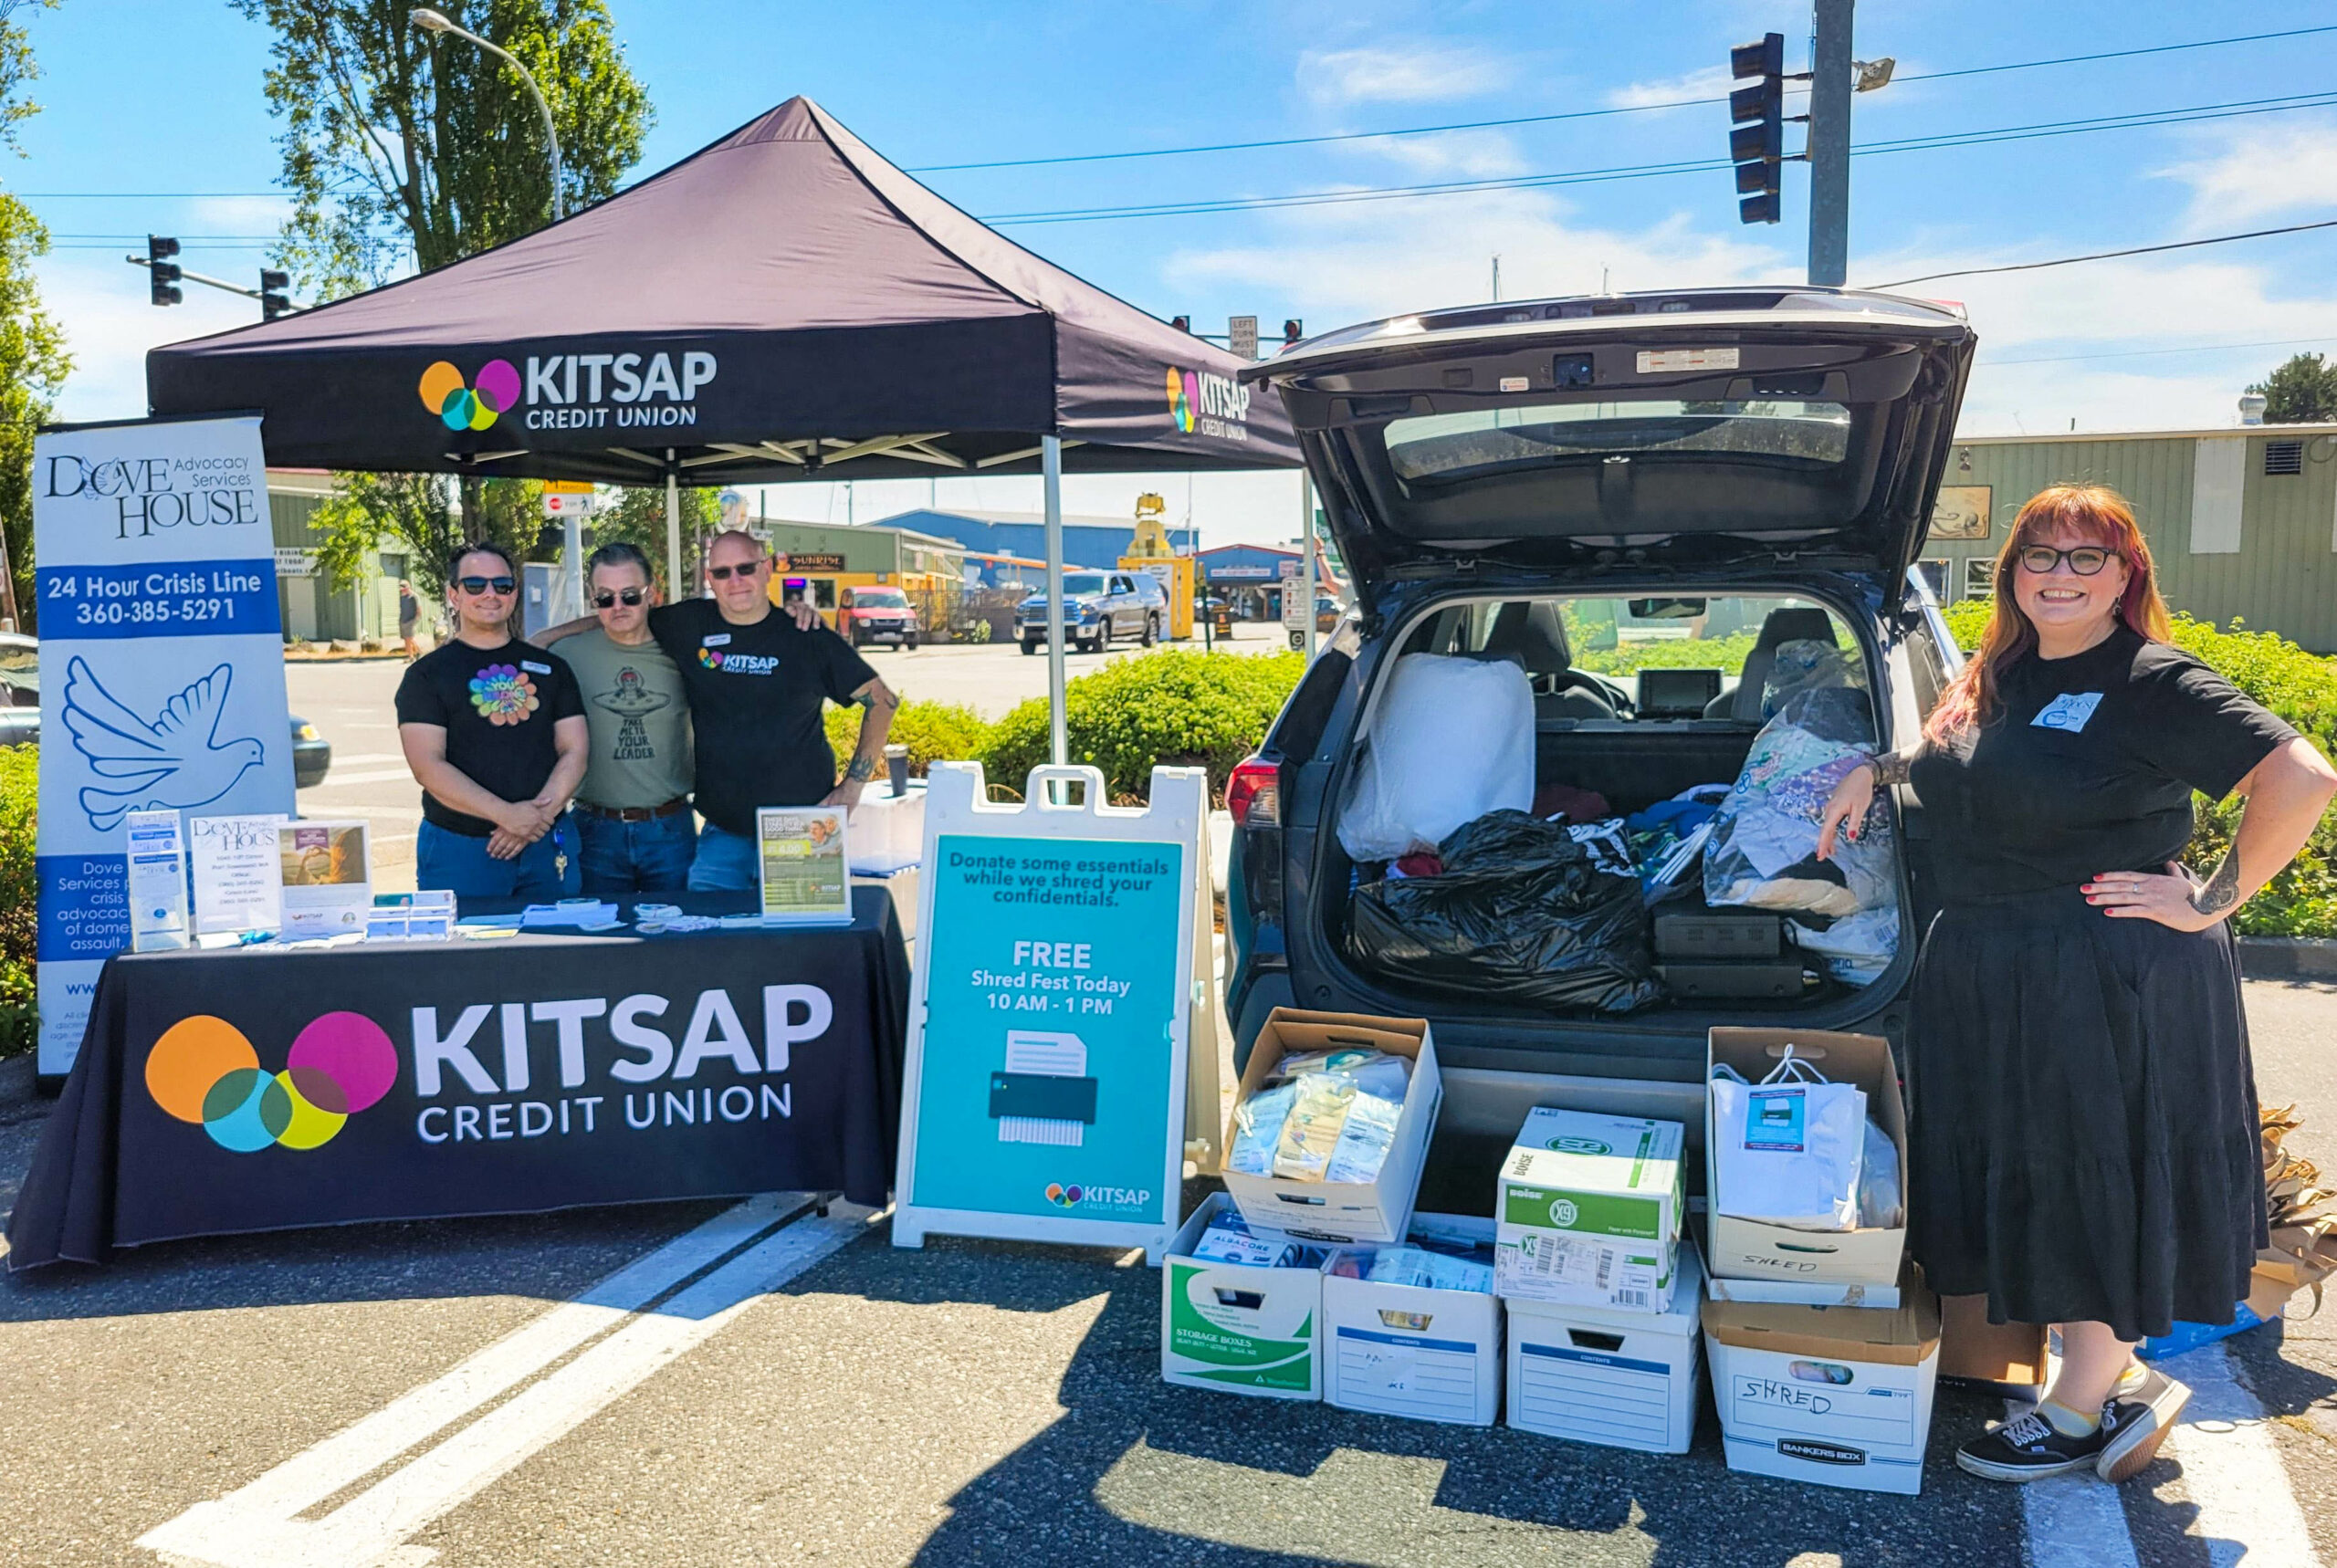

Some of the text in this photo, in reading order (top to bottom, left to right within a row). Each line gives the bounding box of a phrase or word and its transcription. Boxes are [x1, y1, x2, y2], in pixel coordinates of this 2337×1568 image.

[526, 351, 718, 405] KITSAP
[1198, 371, 1250, 422] KITSAP
[526, 406, 697, 430] CREDIT UNION
[1201, 418, 1248, 442] CREDIT UNION
[173, 456, 249, 470] Advocacy
[43, 455, 173, 498] DOVE
[192, 474, 252, 488] Services
[115, 489, 259, 539] HOUSE
[793, 555, 842, 565] SUNRISE
[48, 570, 263, 599] 24 Hour Crisis Line
[77, 598, 236, 625] 360-385-5291
[723, 654, 779, 669] KITSAP
[618, 736, 651, 747] YOUR
[613, 747, 656, 759] LEADER
[222, 831, 275, 851] HOUS
[83, 862, 124, 875] Dove
[950, 852, 1168, 875] Donate some essentials
[58, 877, 121, 891] Services
[963, 869, 1153, 894] while we shred your
[90, 892, 124, 904] crisis
[993, 887, 1119, 907] confidentials.
[57, 908, 129, 922] advocac
[65, 923, 131, 936] of dome
[70, 936, 125, 951] assault,
[1012, 940, 1092, 969] FREE
[971, 969, 1131, 998] Shred Fest Today
[987, 993, 1012, 1010] 10
[1014, 995, 1048, 1012] AM
[1064, 997, 1074, 1013] 1
[1081, 998, 1114, 1015] PM
[411, 983, 834, 1095] KITSAP
[415, 1082, 793, 1144] CREDIT UNION
[1084, 1186, 1150, 1205] KITSAP
[1084, 1202, 1143, 1213] CREDIT UNION
[1555, 1202, 1572, 1220] X9
[1212, 1235, 1270, 1252] ALBACORE
[1742, 1254, 1818, 1272] SHRED
[1176, 1328, 1252, 1347] STORAGE BOXES
[1579, 1354, 1611, 1364] CONTENTS
[1742, 1379, 1831, 1415] SHRED
[1782, 1443, 1861, 1461] BANKERS BOX
